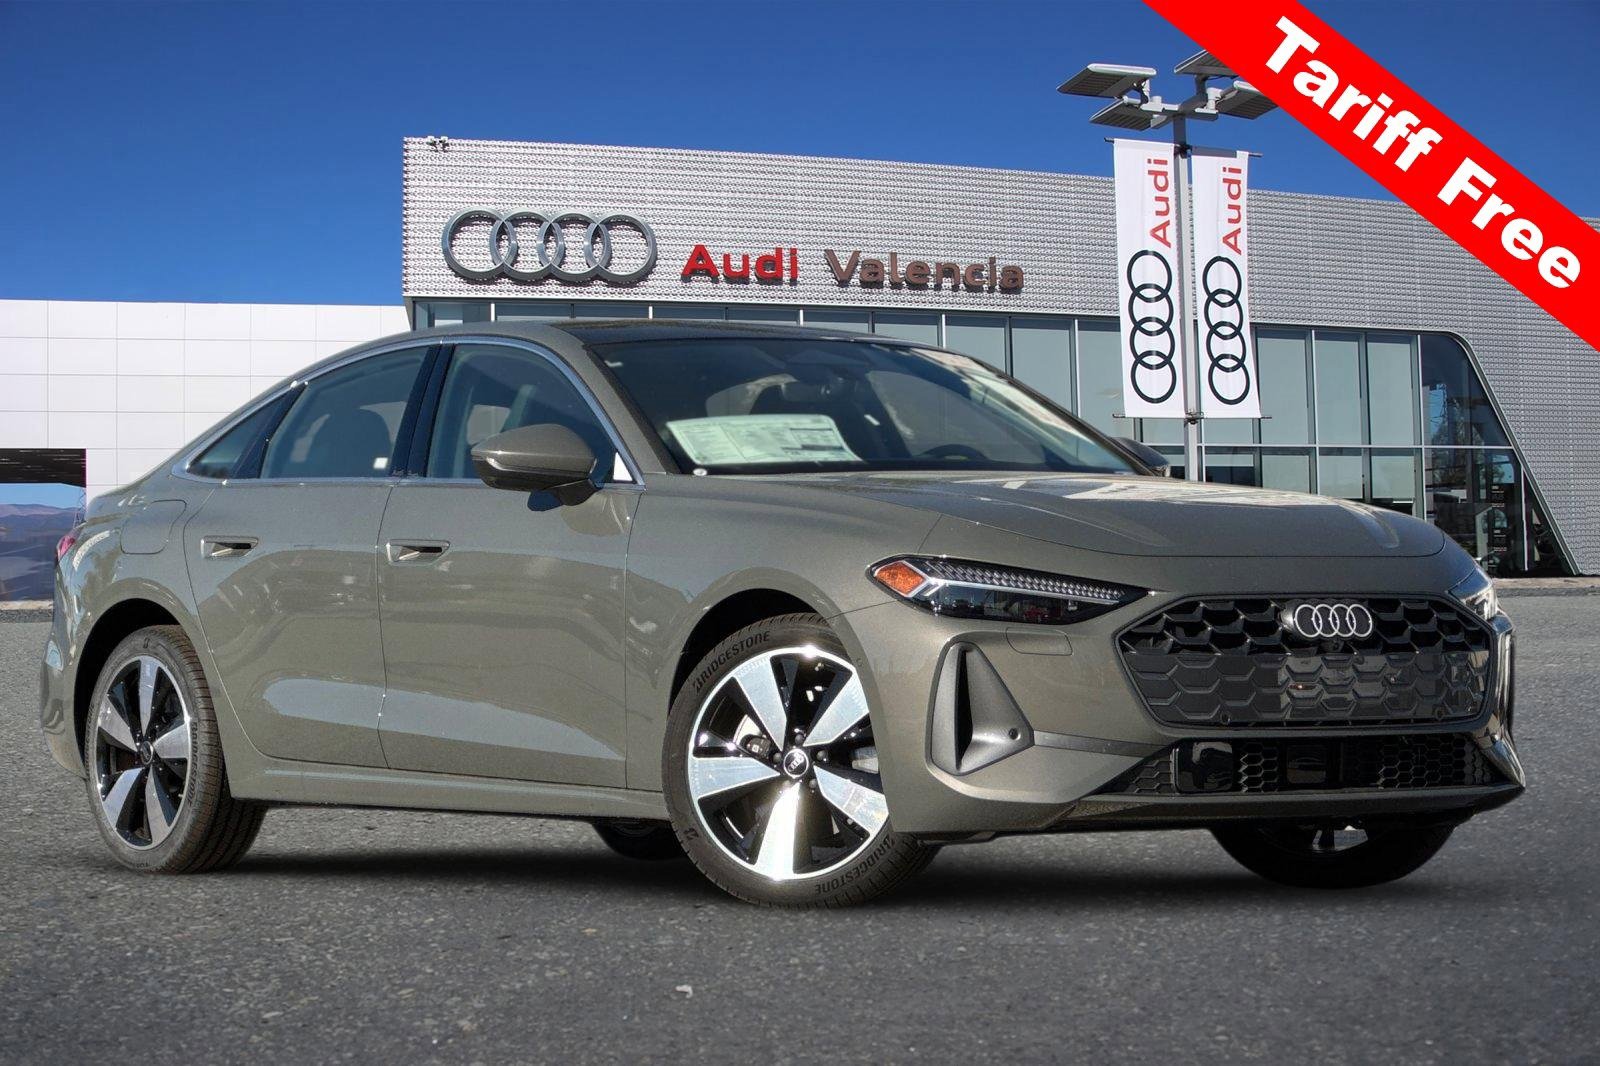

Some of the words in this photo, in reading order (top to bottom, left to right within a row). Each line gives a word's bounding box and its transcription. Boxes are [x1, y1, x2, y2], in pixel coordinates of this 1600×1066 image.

[1147, 158, 1172, 248] Audi
[1221, 166, 1243, 255] Audi
[681, 243, 799, 283] Audi
[825, 249, 1025, 292] Valencia
[692, 630, 770, 694] BRIDGESTONE
